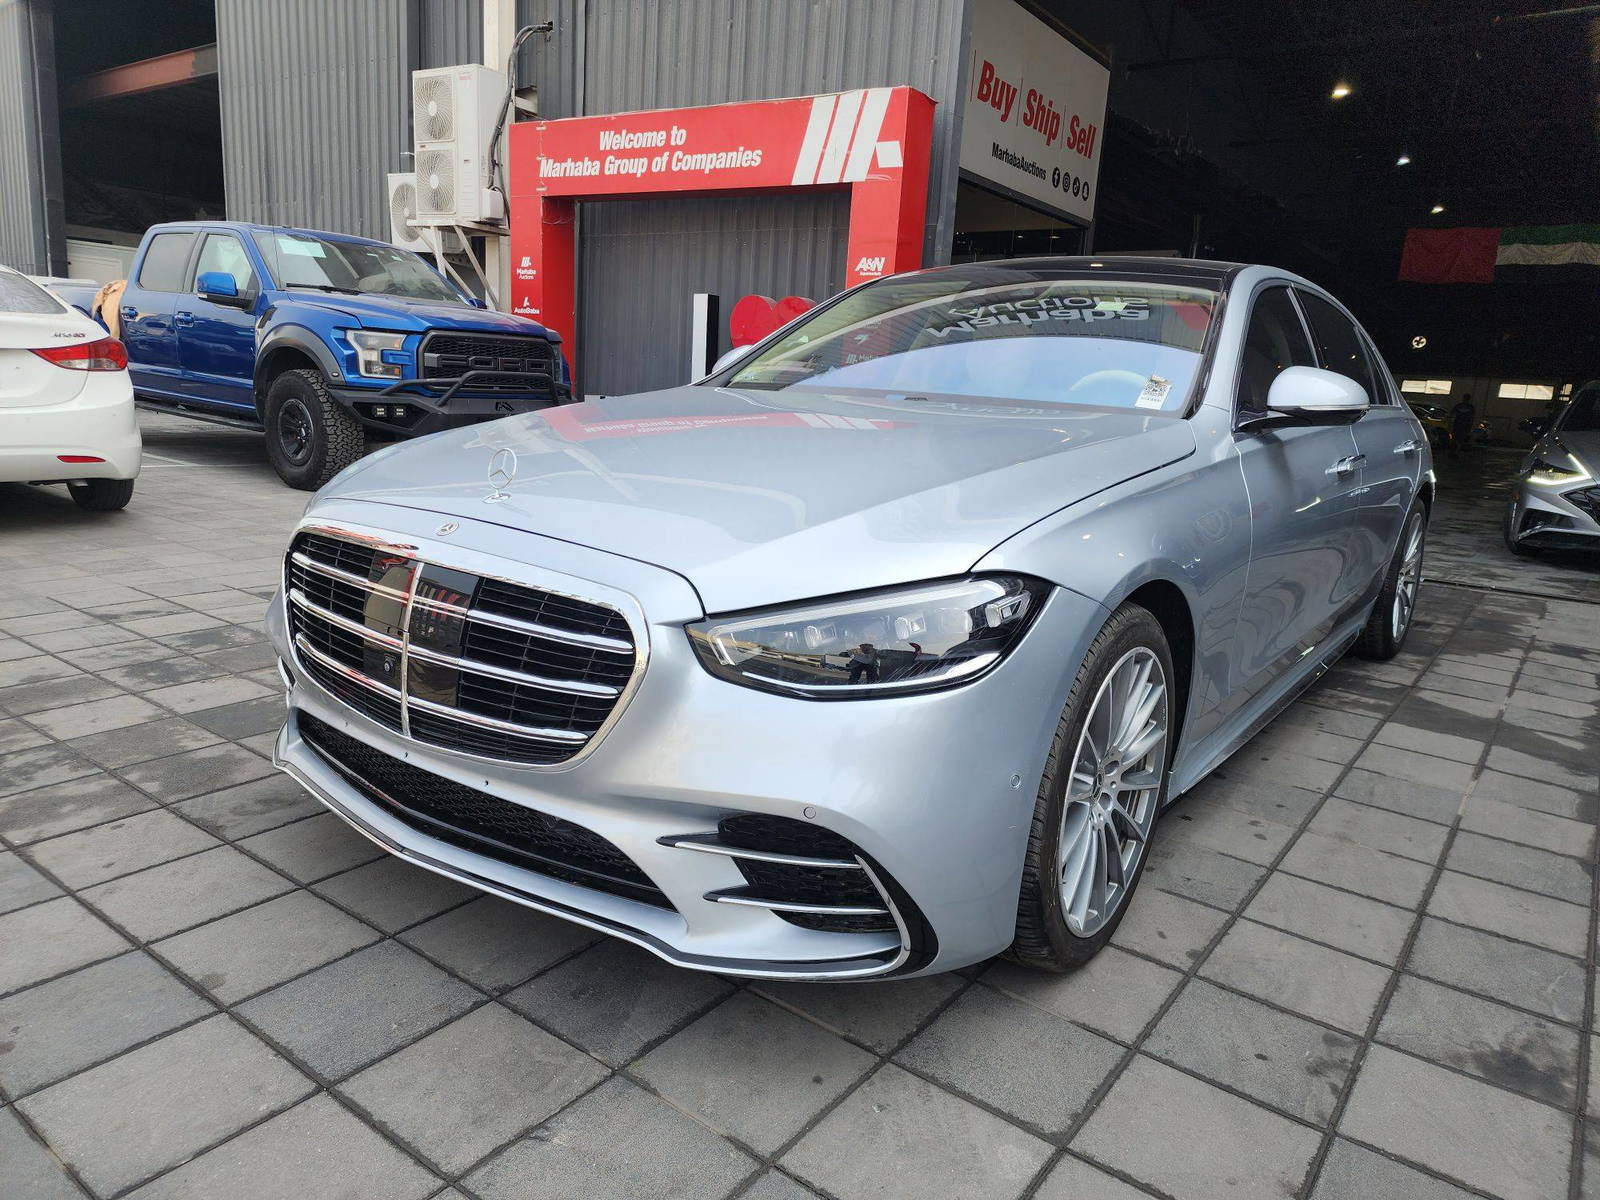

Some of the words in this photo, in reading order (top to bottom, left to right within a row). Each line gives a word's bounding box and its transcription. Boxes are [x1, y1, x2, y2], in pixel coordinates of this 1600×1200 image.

[977, 60, 1018, 123] Buy
[1023, 88, 1061, 146] Ship
[1067, 115, 1097, 159] Sell
[599, 129, 667, 151] Welcome
[670, 125, 687, 146] to
[538, 157, 601, 178] Marhaba
[604, 155, 648, 178] Group
[651, 152, 670, 173] of
[671, 146, 763, 174] Companies
[991, 142, 1047, 181] MarhabaAuctions
[855, 257, 886, 272] A&N
